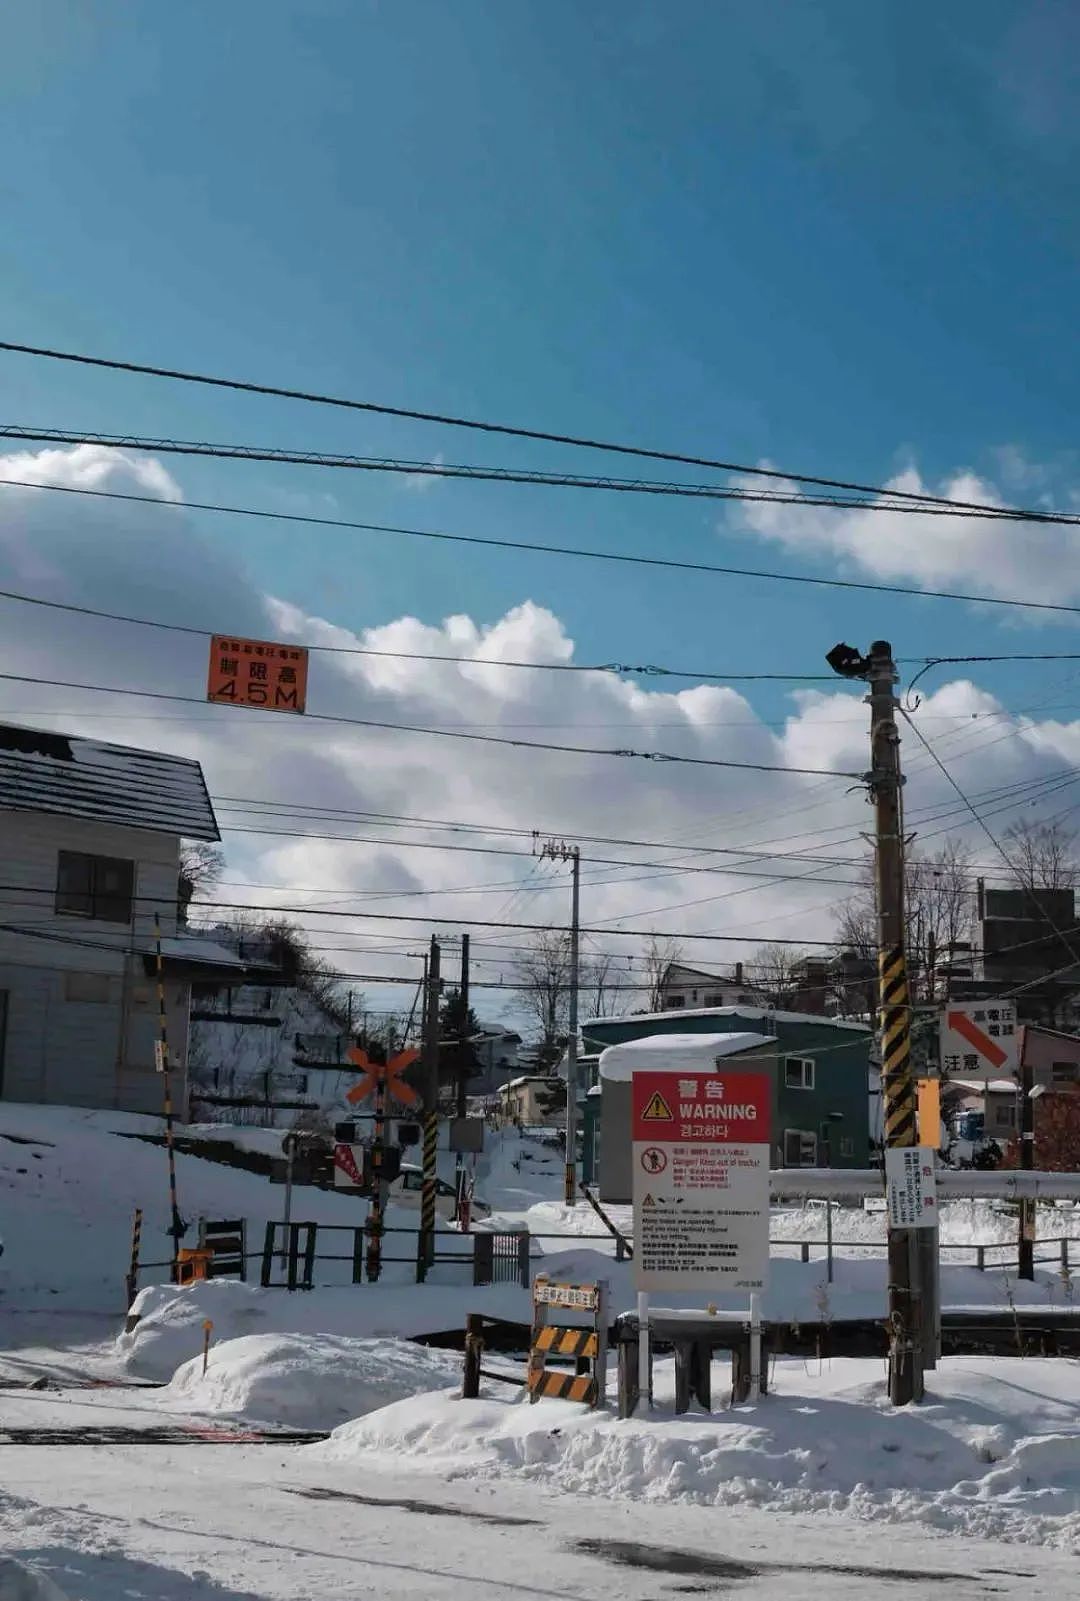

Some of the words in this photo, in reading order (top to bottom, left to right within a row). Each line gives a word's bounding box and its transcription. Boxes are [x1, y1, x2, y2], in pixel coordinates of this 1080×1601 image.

[220, 656, 297, 684] 制限高
[216, 679, 298, 709] 4.5M
[944, 1054, 980, 1073] 注意
[678, 1079, 725, 1099] 警告
[679, 1103, 757, 1120] WARNING
[680, 1124, 729, 1138] 경고하다
